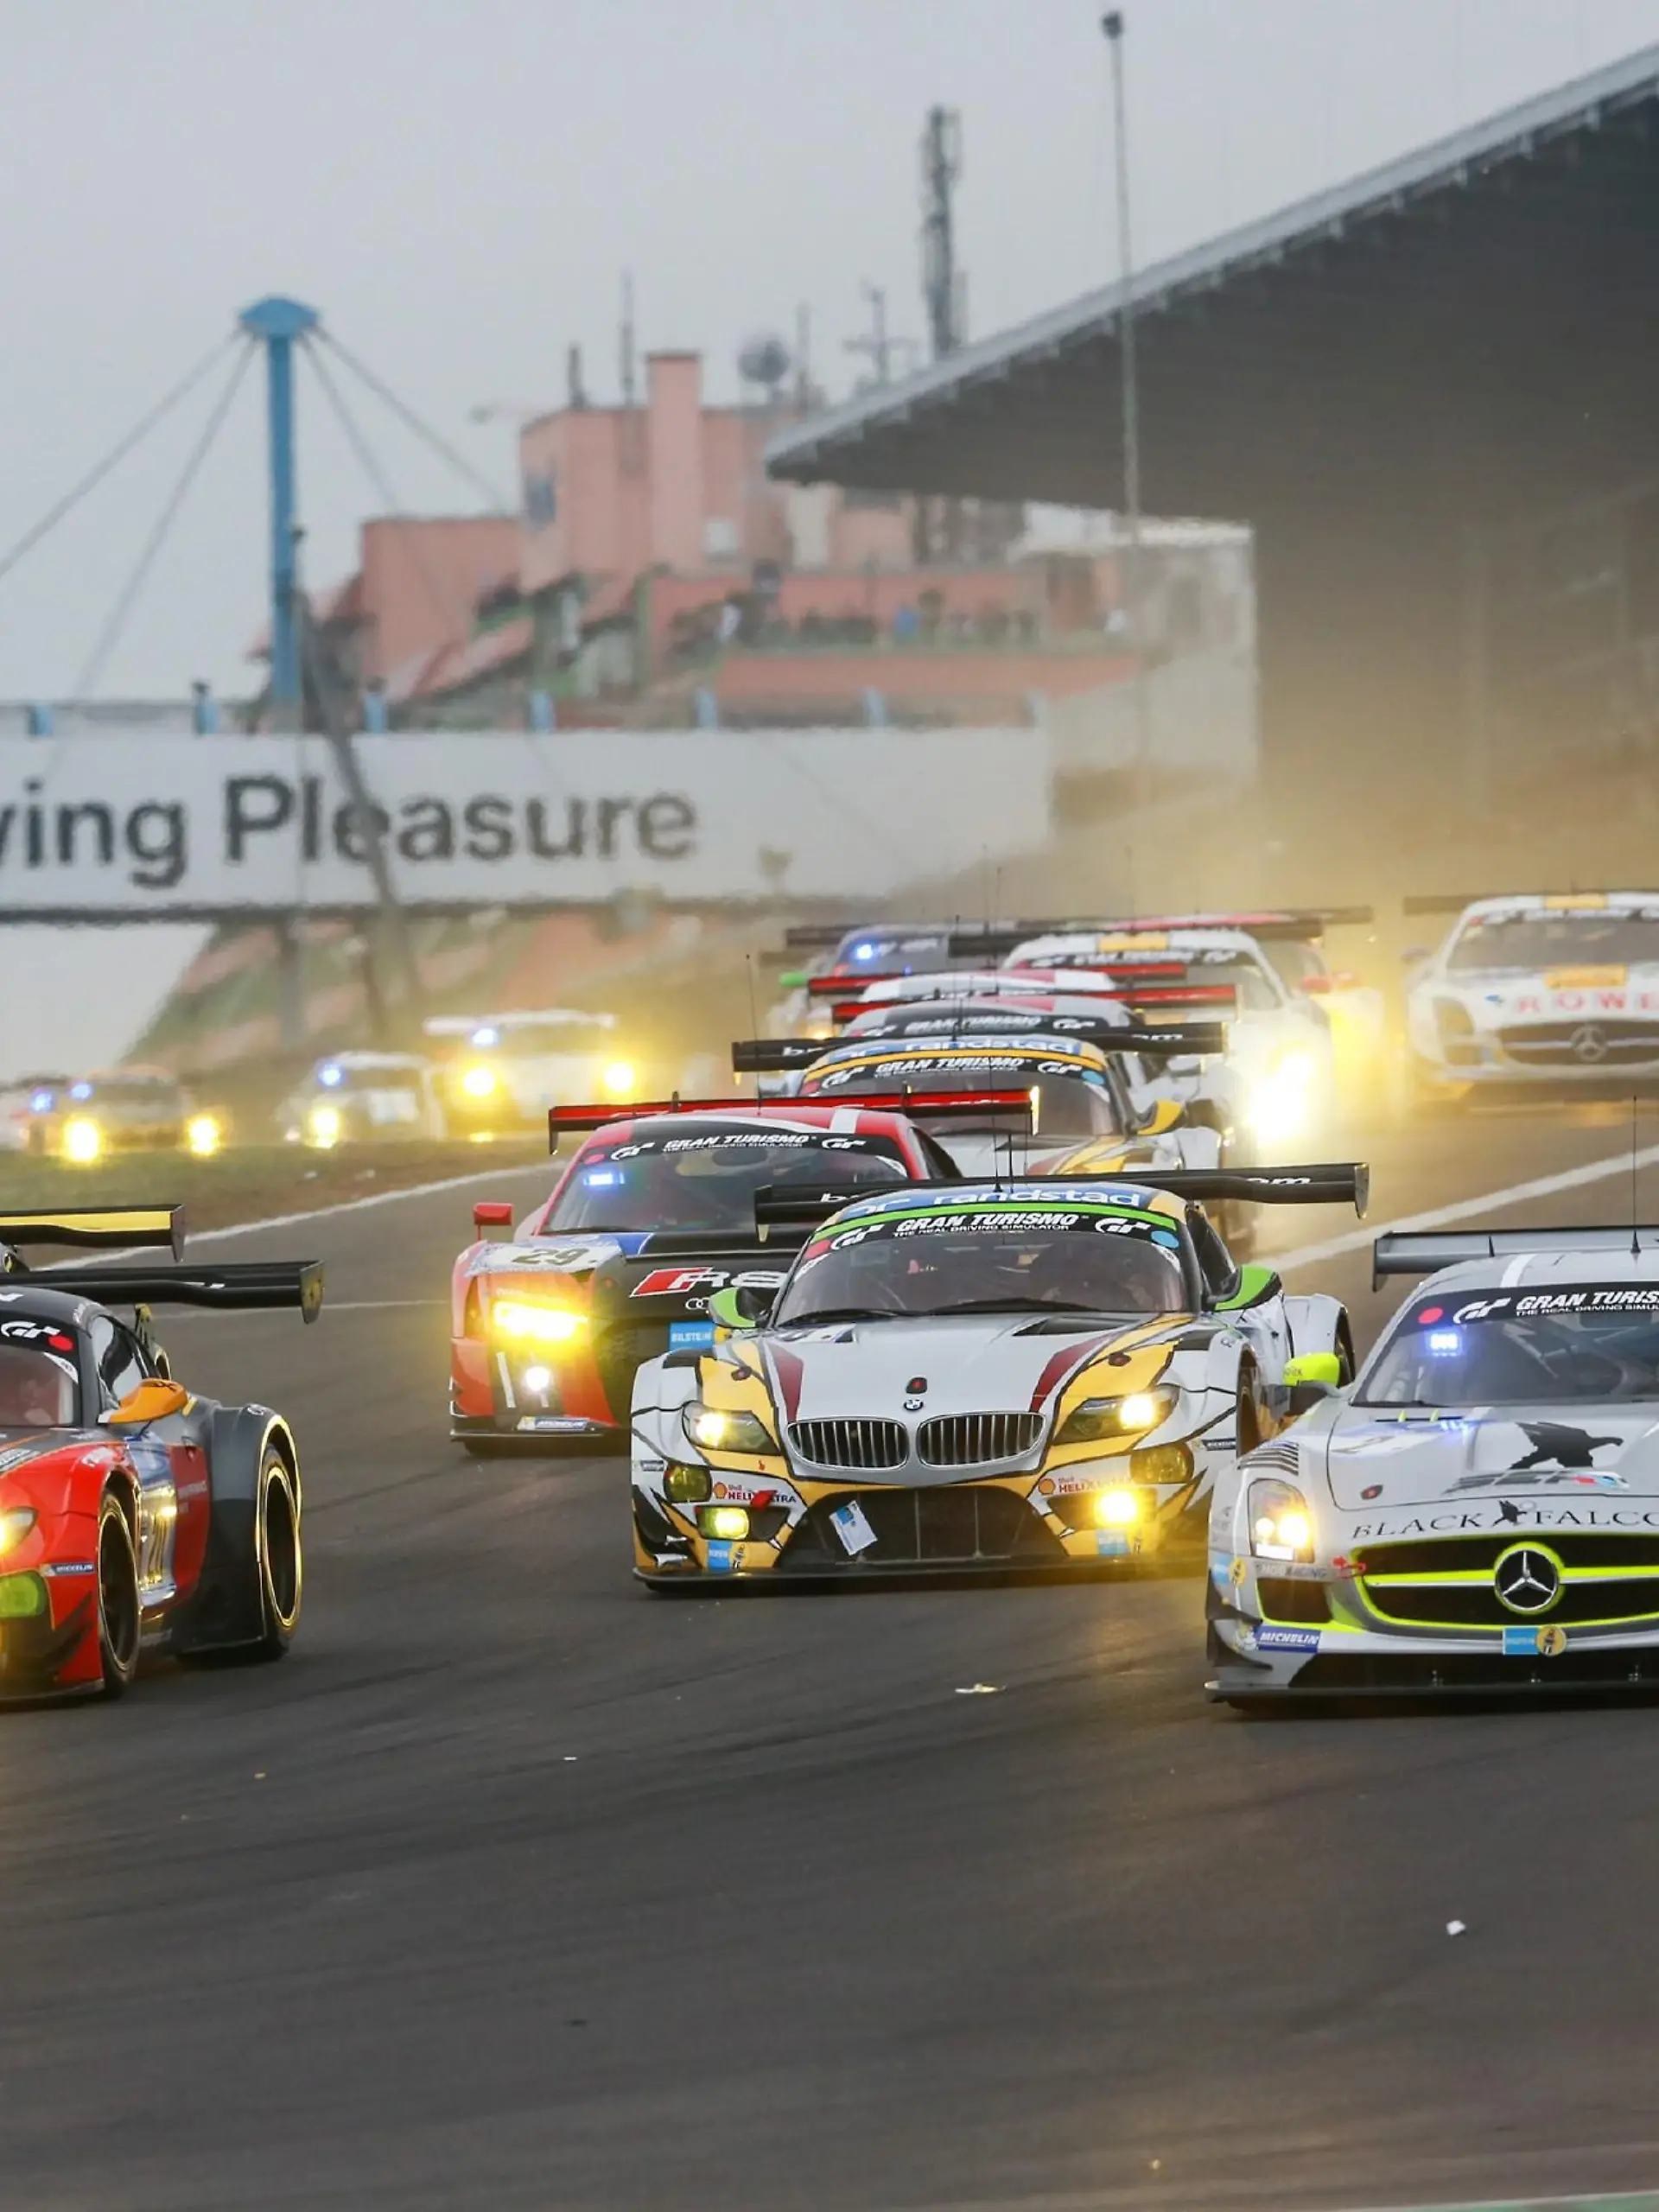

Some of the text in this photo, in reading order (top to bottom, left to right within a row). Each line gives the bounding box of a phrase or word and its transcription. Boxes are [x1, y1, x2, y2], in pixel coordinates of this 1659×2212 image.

[0, 774, 695, 889] ing Pleasure
[664, 1135, 721, 1149] GRAN
[724, 1135, 810, 1145] TURISMO
[933, 1189, 1140, 1206] randstad
[896, 1212, 1080, 1233] GRAN TURISMO
[1516, 1293, 1587, 1311] GRAN
[1351, 1511, 1482, 1540] BLACK
[1260, 1631, 1319, 1644] MICHELIN
